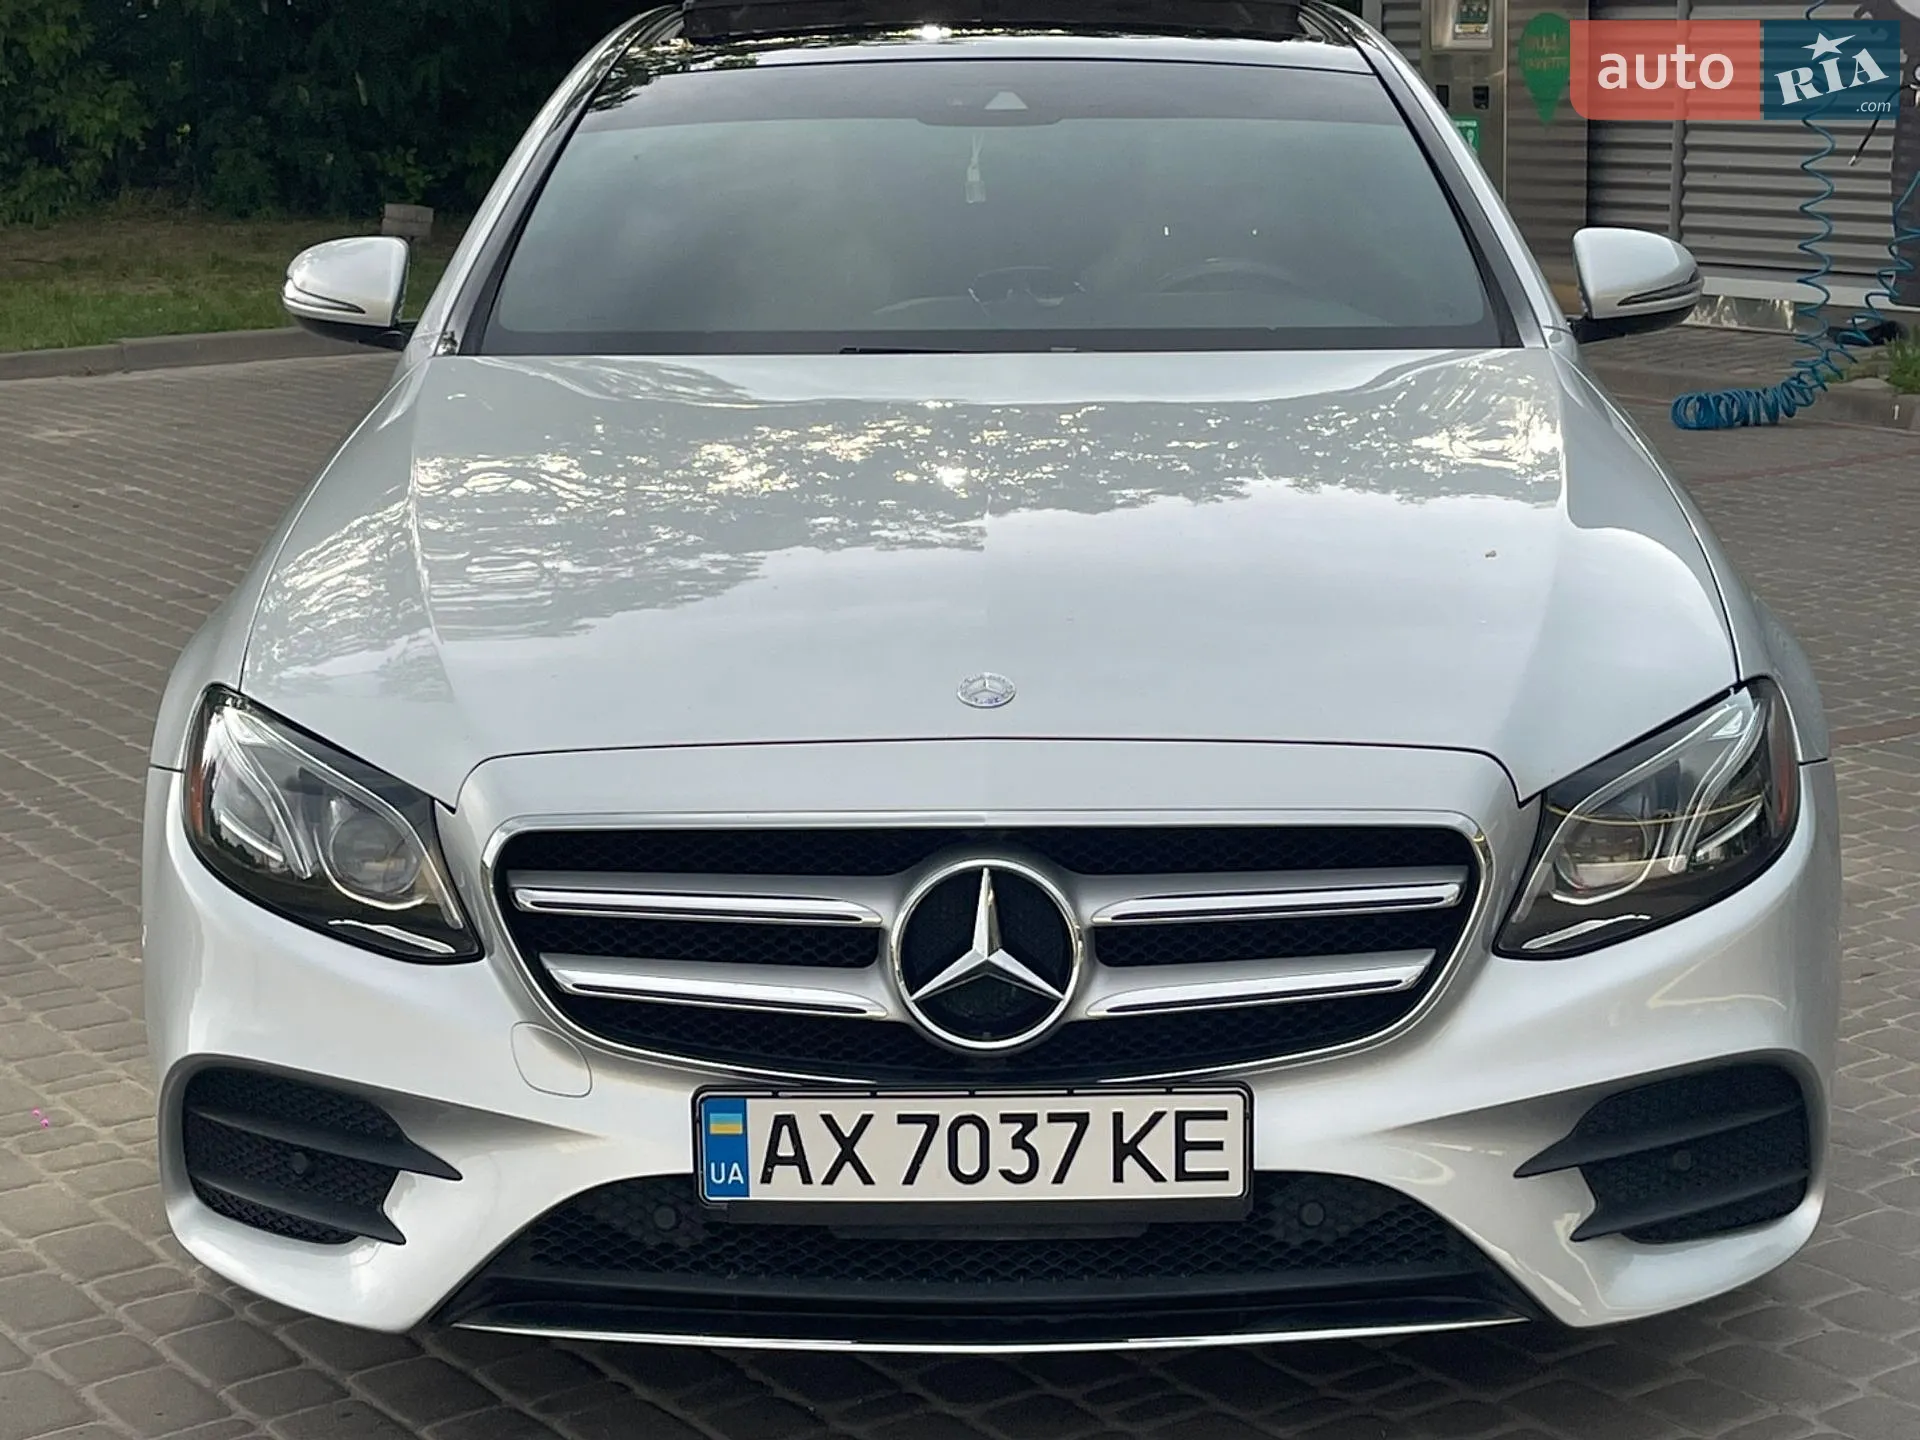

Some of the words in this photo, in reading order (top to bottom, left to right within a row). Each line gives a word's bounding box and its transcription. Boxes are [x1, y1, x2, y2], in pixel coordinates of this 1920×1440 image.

[710, 1161, 745, 1185] UA
[759, 1113, 876, 1186] AX
[896, 1111, 1091, 1186] 7037
[1111, 1110, 1230, 1184] KE
